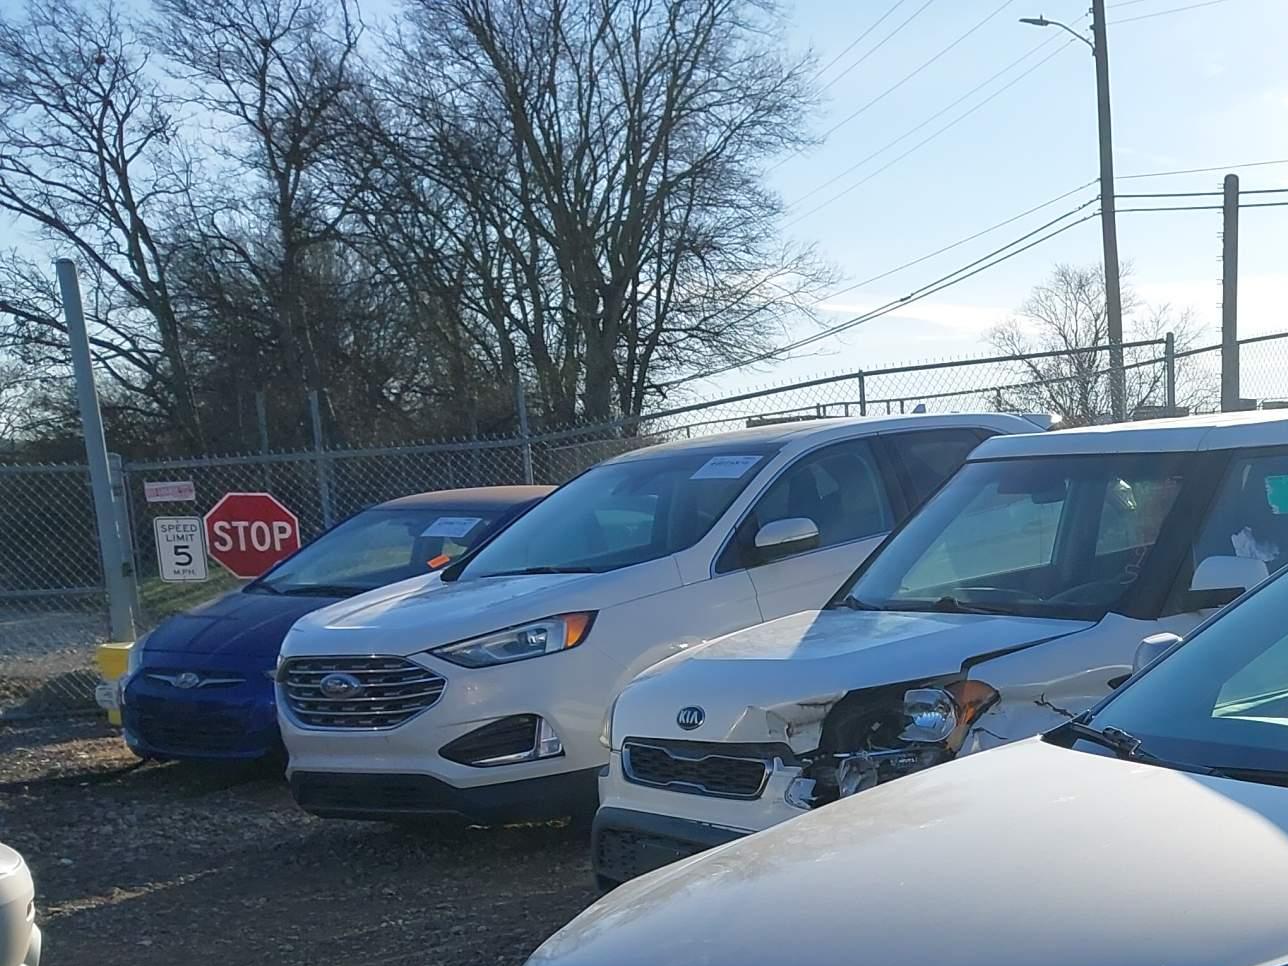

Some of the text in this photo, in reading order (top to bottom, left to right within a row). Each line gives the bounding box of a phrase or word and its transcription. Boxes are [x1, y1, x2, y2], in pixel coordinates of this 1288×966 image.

[160, 524, 198, 533] SPEED
[166, 534, 195, 543] LIMIT
[213, 520, 292, 552] STOP
[173, 545, 193, 567] 5
[678, 711, 699, 724] KIA
